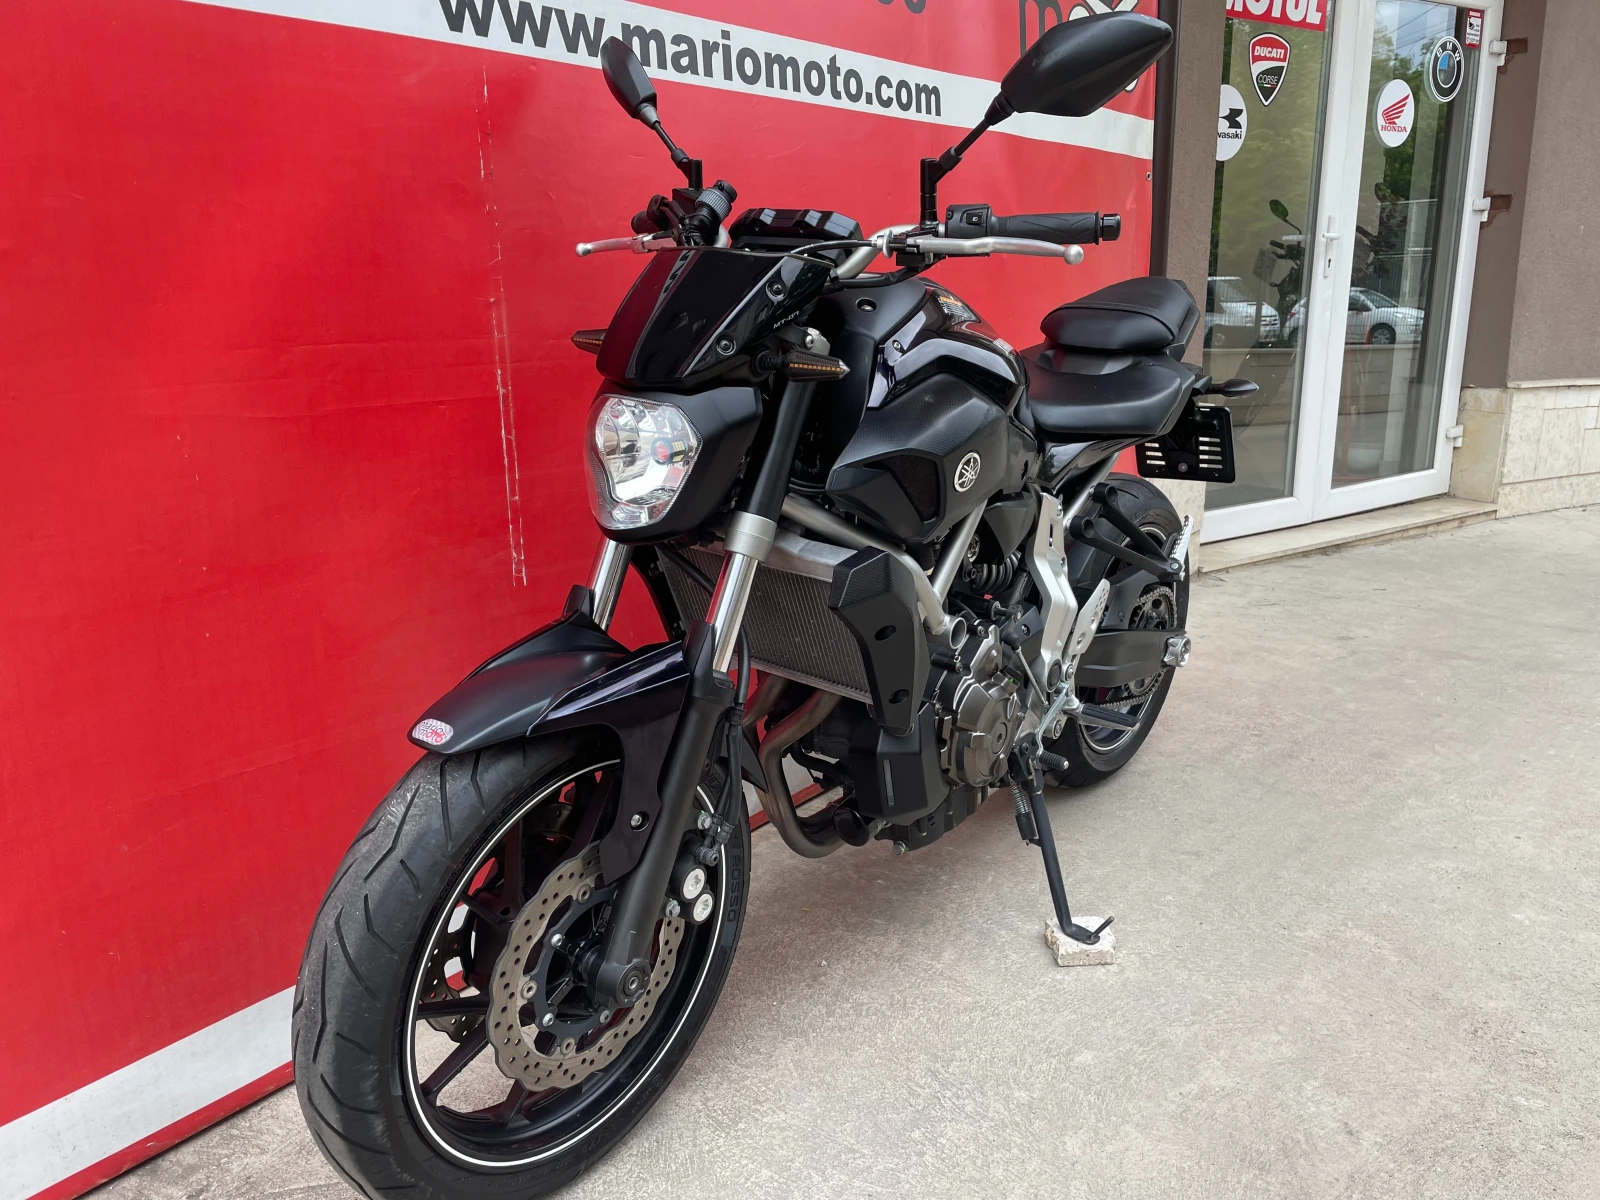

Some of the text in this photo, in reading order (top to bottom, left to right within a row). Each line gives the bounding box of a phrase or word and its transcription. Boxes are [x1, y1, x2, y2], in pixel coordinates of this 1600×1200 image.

[1254, 46, 1285, 59] DUCATI
[1436, 41, 1461, 62] BMW
[438, 0, 942, 117] wwwmariomoto.com
[1258, 74, 1279, 85] CORSE
[1217, 130, 1243, 140] wasaki
[1380, 125, 1408, 133] HONDA
[773, 310, 800, 329] MT-07
[420, 721, 444, 734] mario
[727, 854, 741, 923] ROSSO
